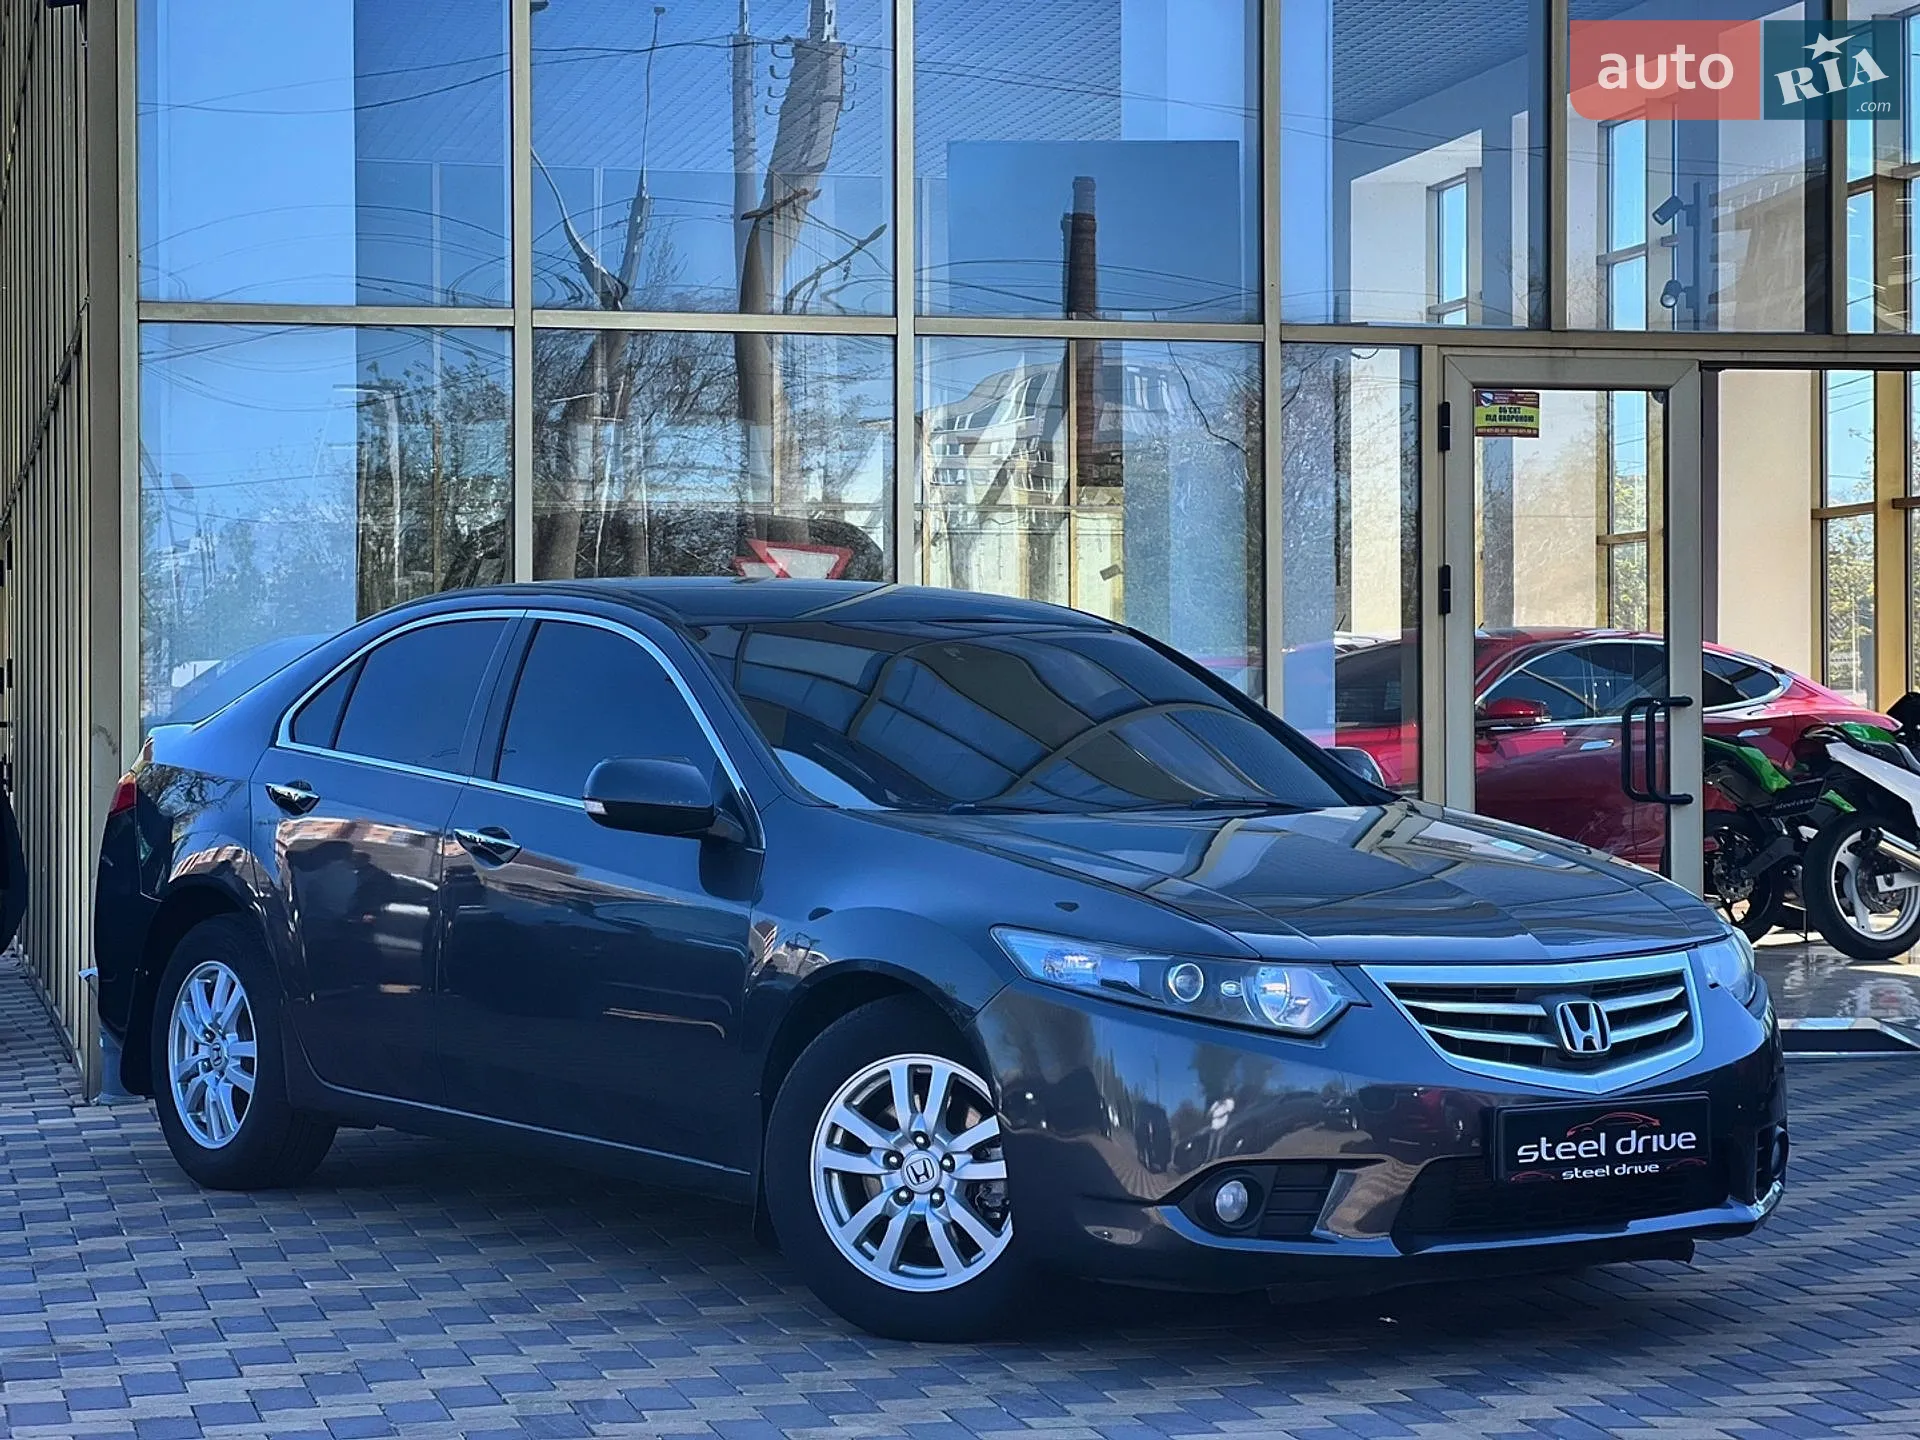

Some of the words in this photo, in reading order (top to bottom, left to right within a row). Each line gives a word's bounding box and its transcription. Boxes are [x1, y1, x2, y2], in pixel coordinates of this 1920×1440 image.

[1517, 1132, 1606, 1163] steel
[1615, 1129, 1697, 1155] drive
[1562, 1164, 1610, 1180] steel
[1614, 1163, 1660, 1175] drive
